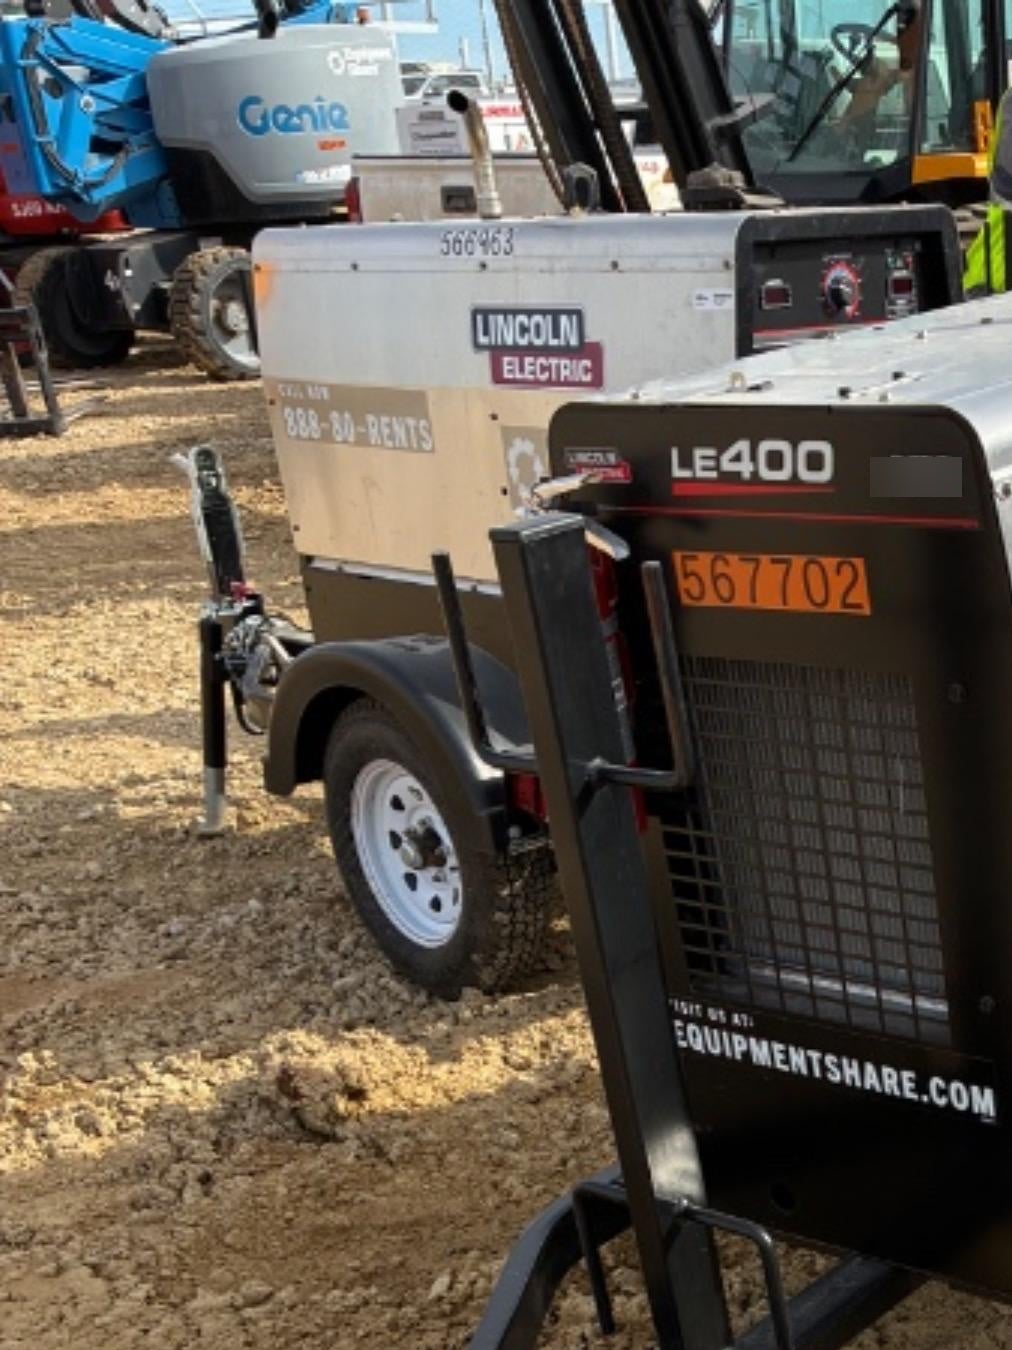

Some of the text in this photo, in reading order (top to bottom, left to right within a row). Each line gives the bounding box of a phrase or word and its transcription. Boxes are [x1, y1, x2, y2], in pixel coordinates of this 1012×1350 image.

[238, 95, 350, 136] Genie
[475, 314, 579, 346] LINCOLN
[502, 356, 593, 382] ELECTRIC
[284, 407, 434, 451] 888-80-RENTS
[671, 439, 835, 484] LE400
[681, 554, 866, 611] 567702
[673, 1019, 996, 1118] EQUIPMENTSHARE.COM
